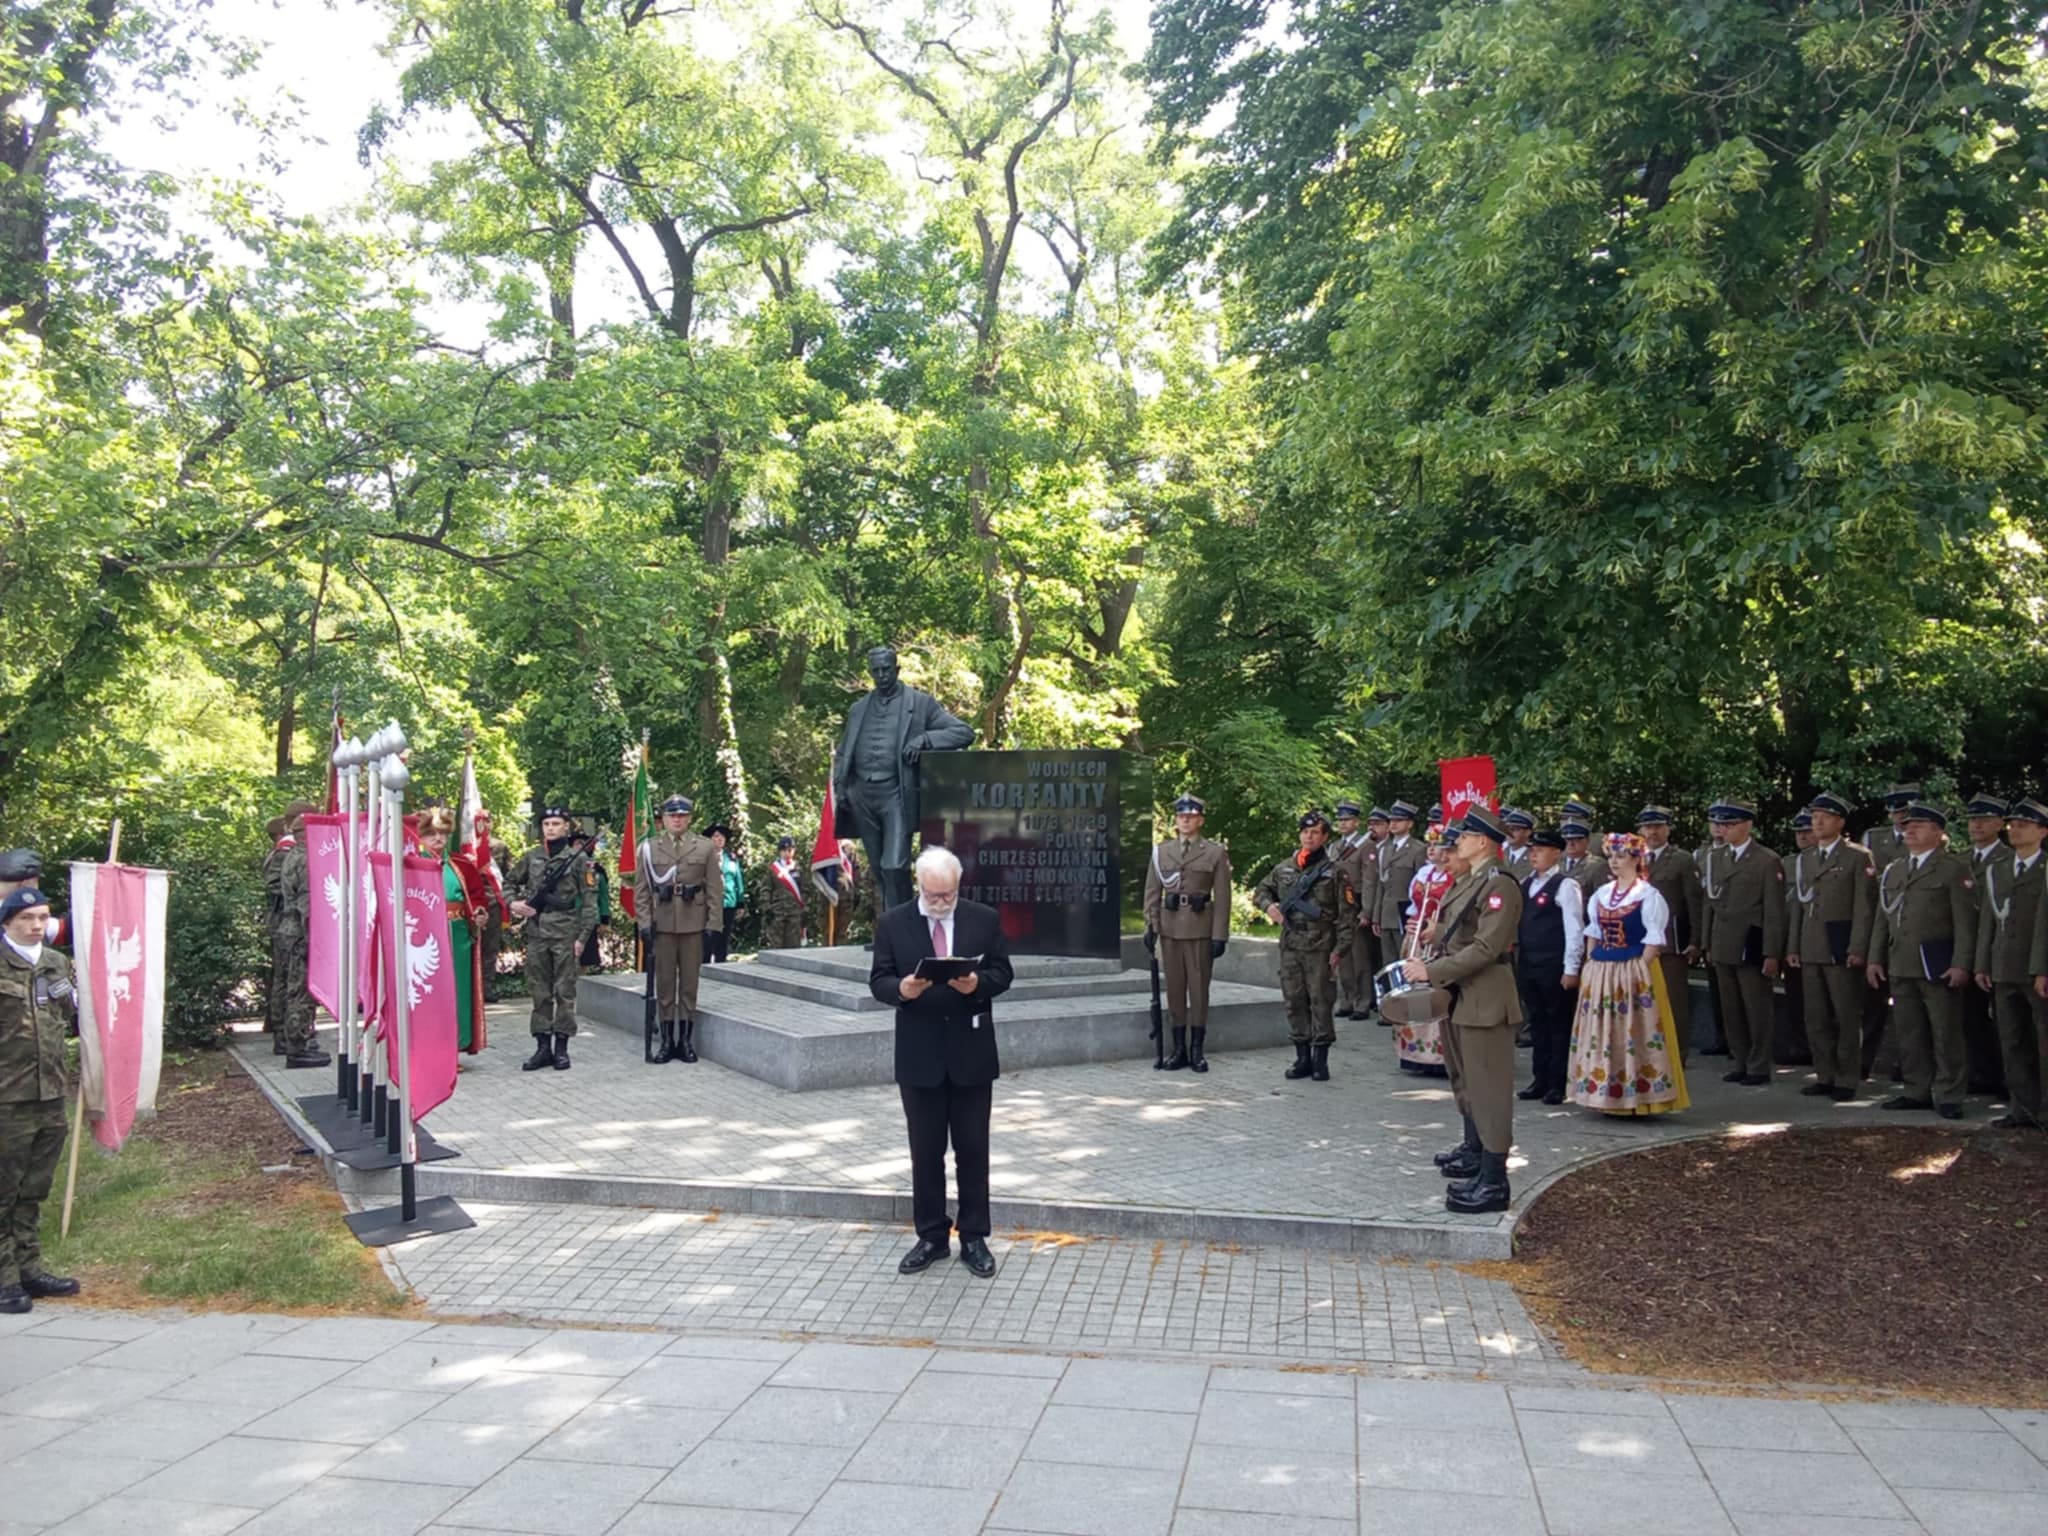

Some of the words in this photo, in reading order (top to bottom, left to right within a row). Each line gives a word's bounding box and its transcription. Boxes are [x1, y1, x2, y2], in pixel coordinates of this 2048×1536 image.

[1027, 761, 1108, 777] WOJCIECH
[971, 782, 1106, 808] KORFANTY
[1014, 868, 1107, 885] DEMOKRATA
